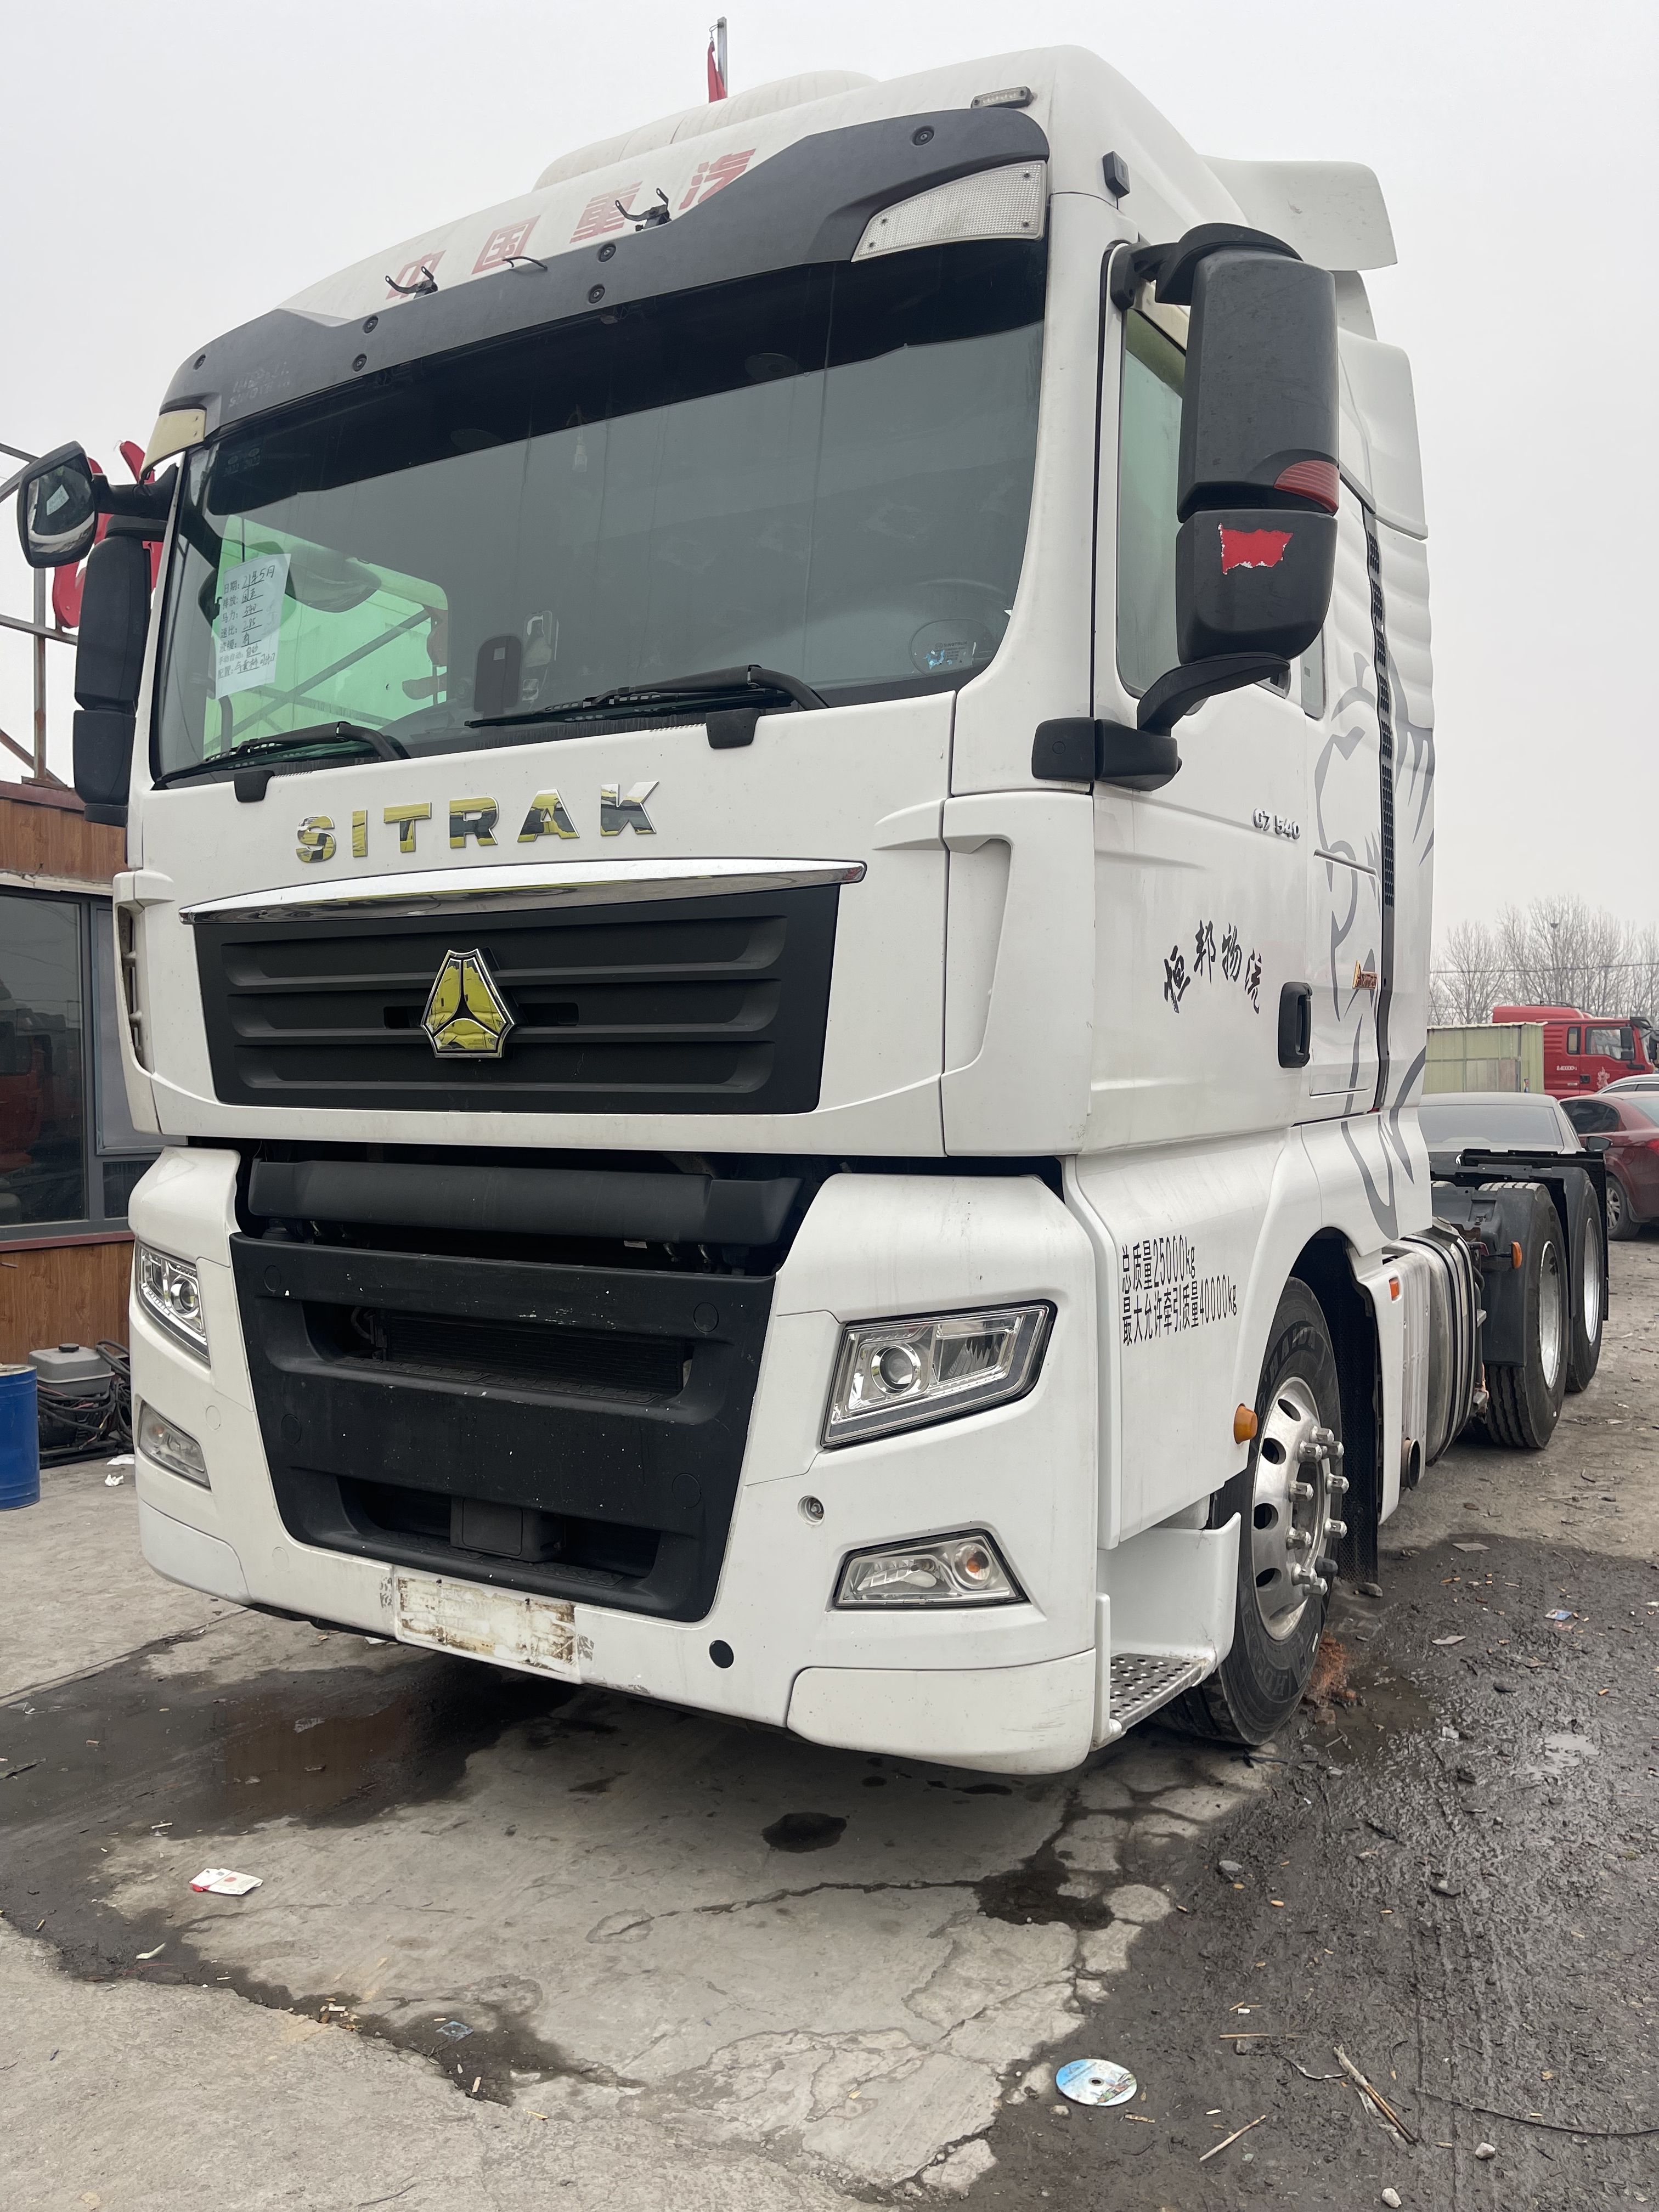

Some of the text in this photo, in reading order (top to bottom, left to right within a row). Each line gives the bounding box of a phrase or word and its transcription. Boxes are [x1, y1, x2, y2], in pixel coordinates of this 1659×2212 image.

[386, 148, 757, 301] 中国重汽
[296, 781, 660, 863] SITRAK
[1274, 815, 1300, 840] 540
[1122, 1234, 1195, 1294] 总质量25000kg
[1122, 1274, 1237, 1346] 最大允许牵引质量40000kg
